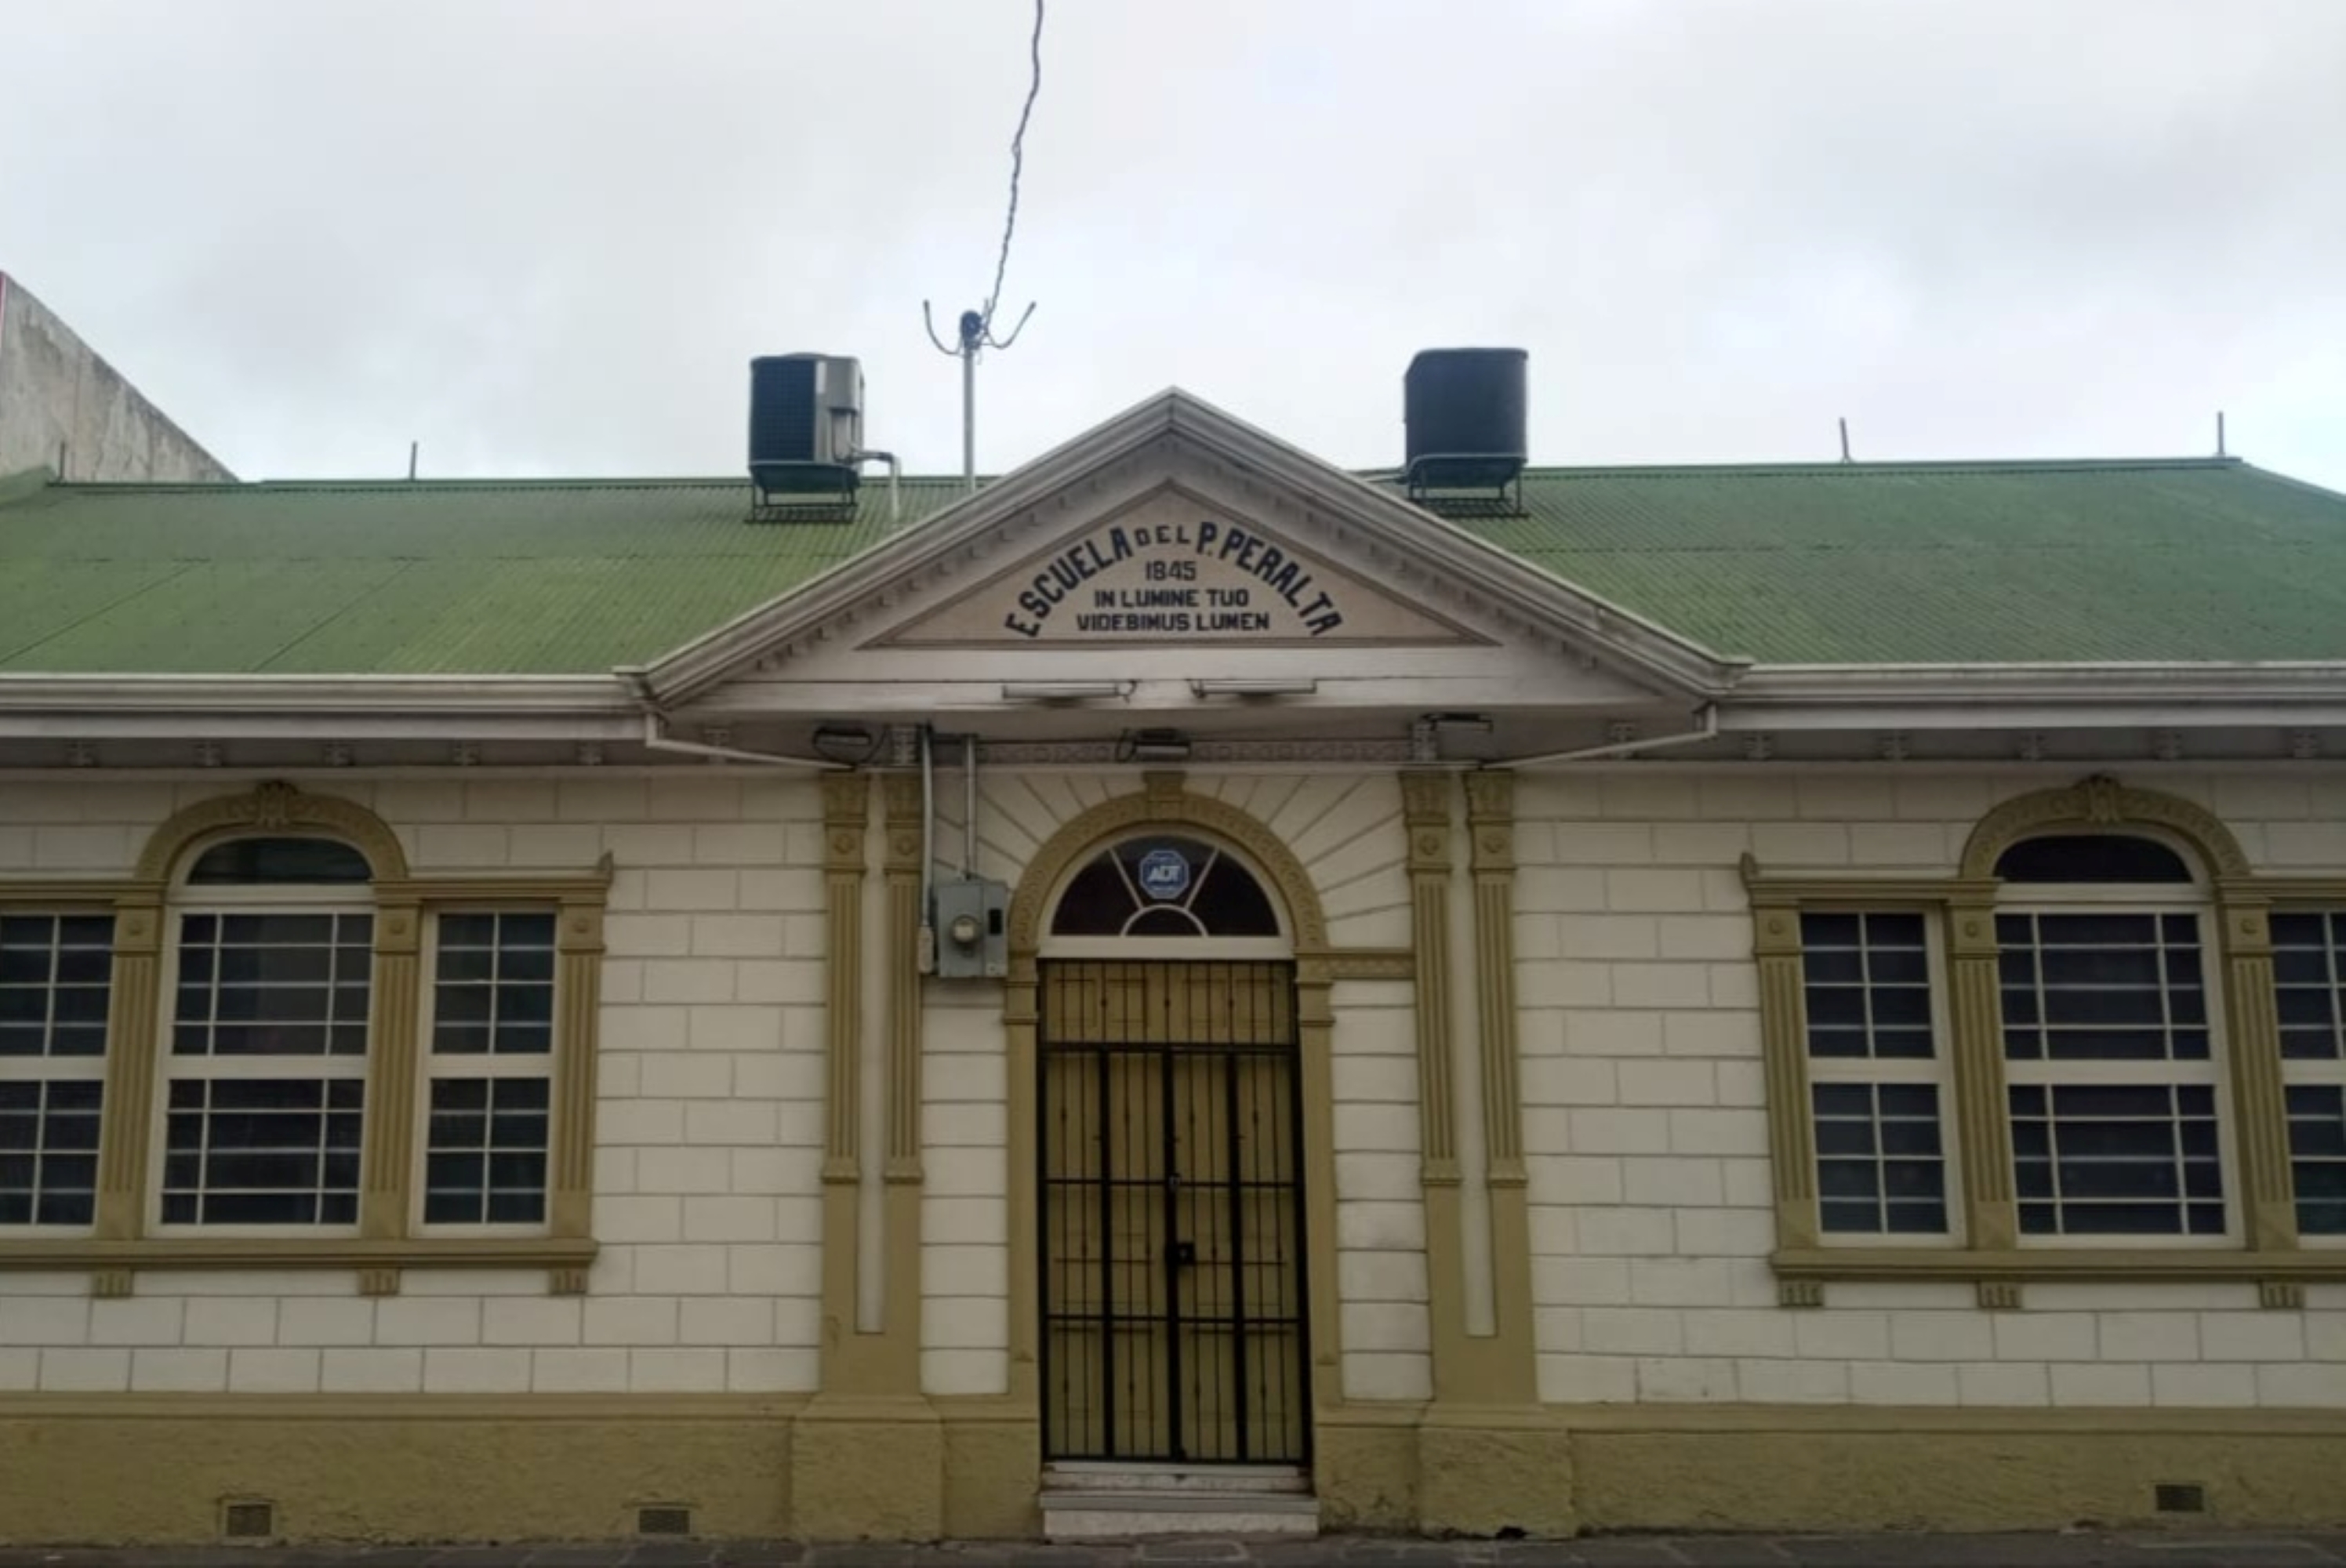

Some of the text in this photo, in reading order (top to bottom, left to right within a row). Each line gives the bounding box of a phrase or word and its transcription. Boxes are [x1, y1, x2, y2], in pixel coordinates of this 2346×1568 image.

[1146, 560, 1197, 582] 1845
[1004, 526, 1133, 638] ESCUELA
[1134, 524, 1191, 547] DEL
[1095, 590, 1250, 608] IN LUMINE TUO
[1077, 613, 1270, 632] VIDEBIMUS LUMEN
[1146, 865, 1181, 883] ADT
